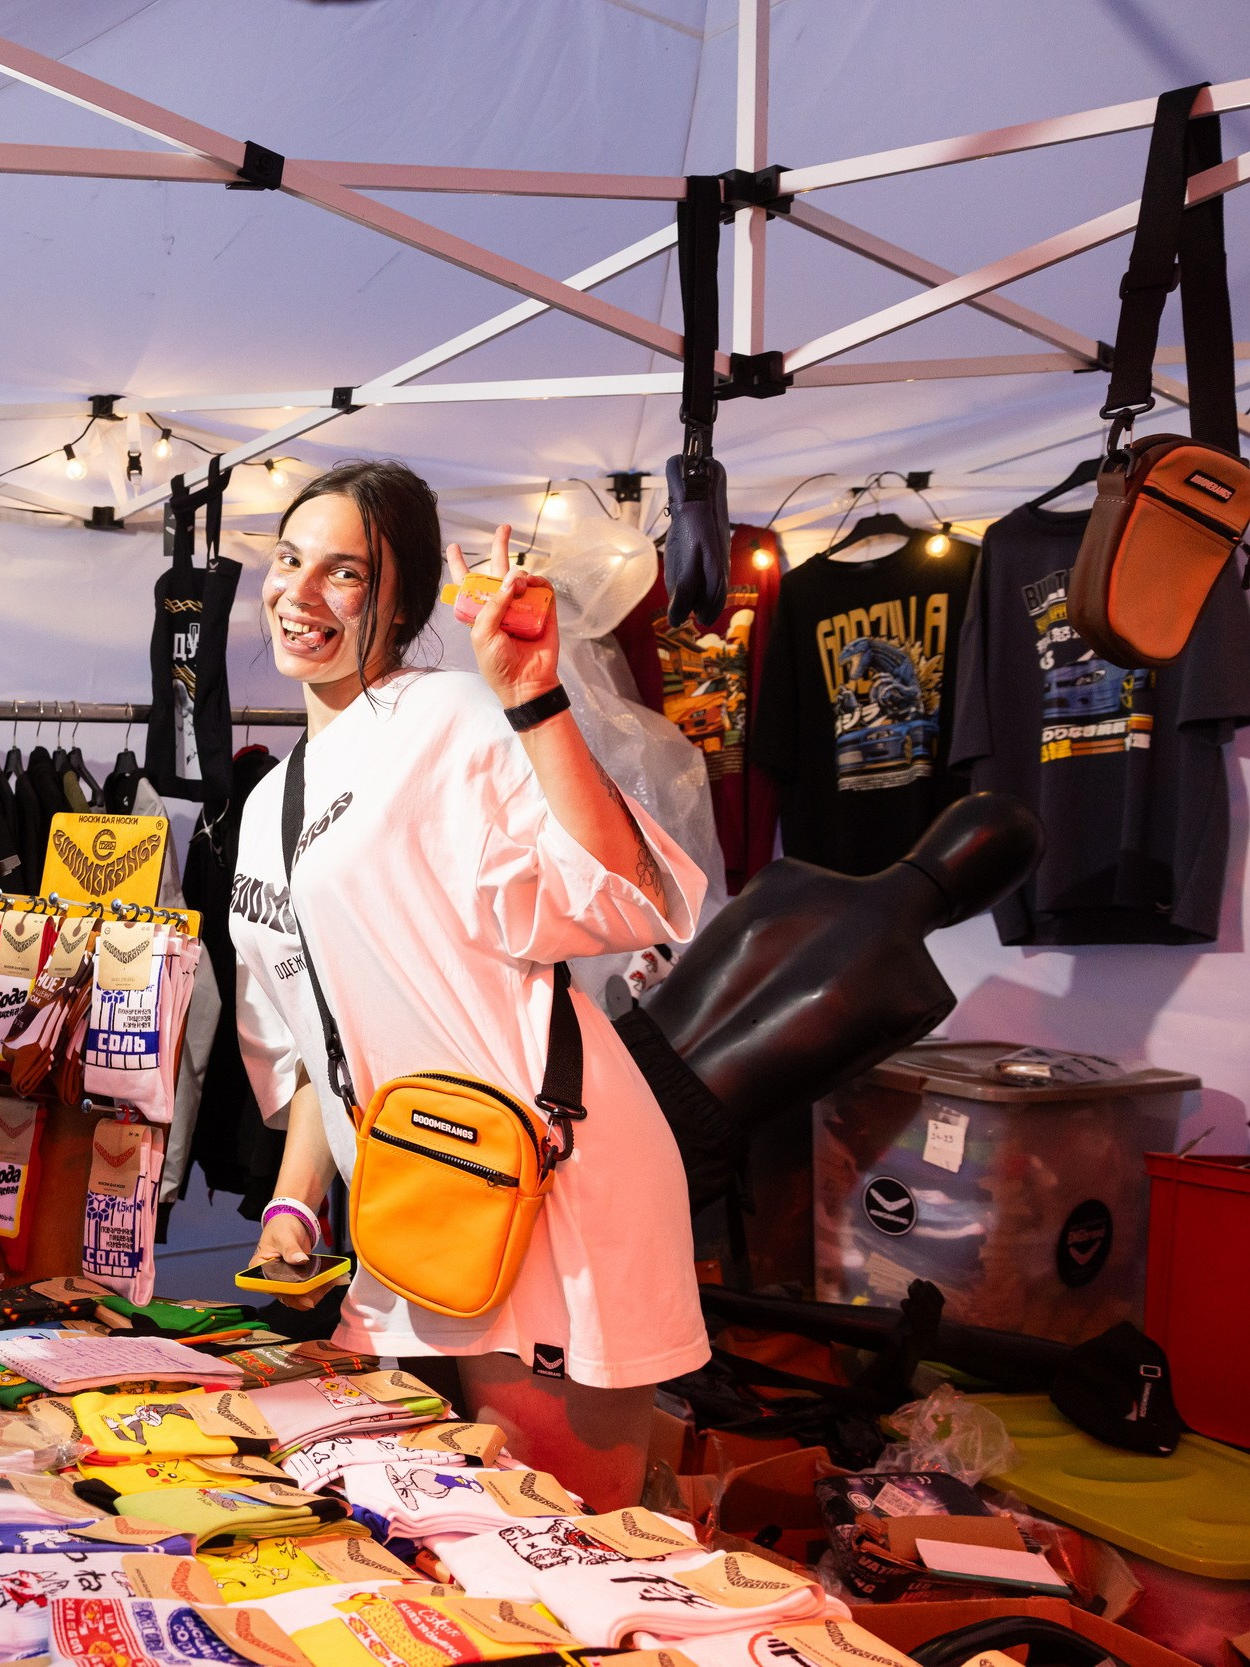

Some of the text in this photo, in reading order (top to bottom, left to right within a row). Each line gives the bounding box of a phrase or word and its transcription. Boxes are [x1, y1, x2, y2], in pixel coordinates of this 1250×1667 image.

[78, 815, 139, 825] НОСКИ ДЛЯ НОСКИ
[97, 1032, 146, 1053] СОЛЬ
[413, 1113, 474, 1140] BOOOMERANGS
[86, 1248, 130, 1267] СОЛЬ
